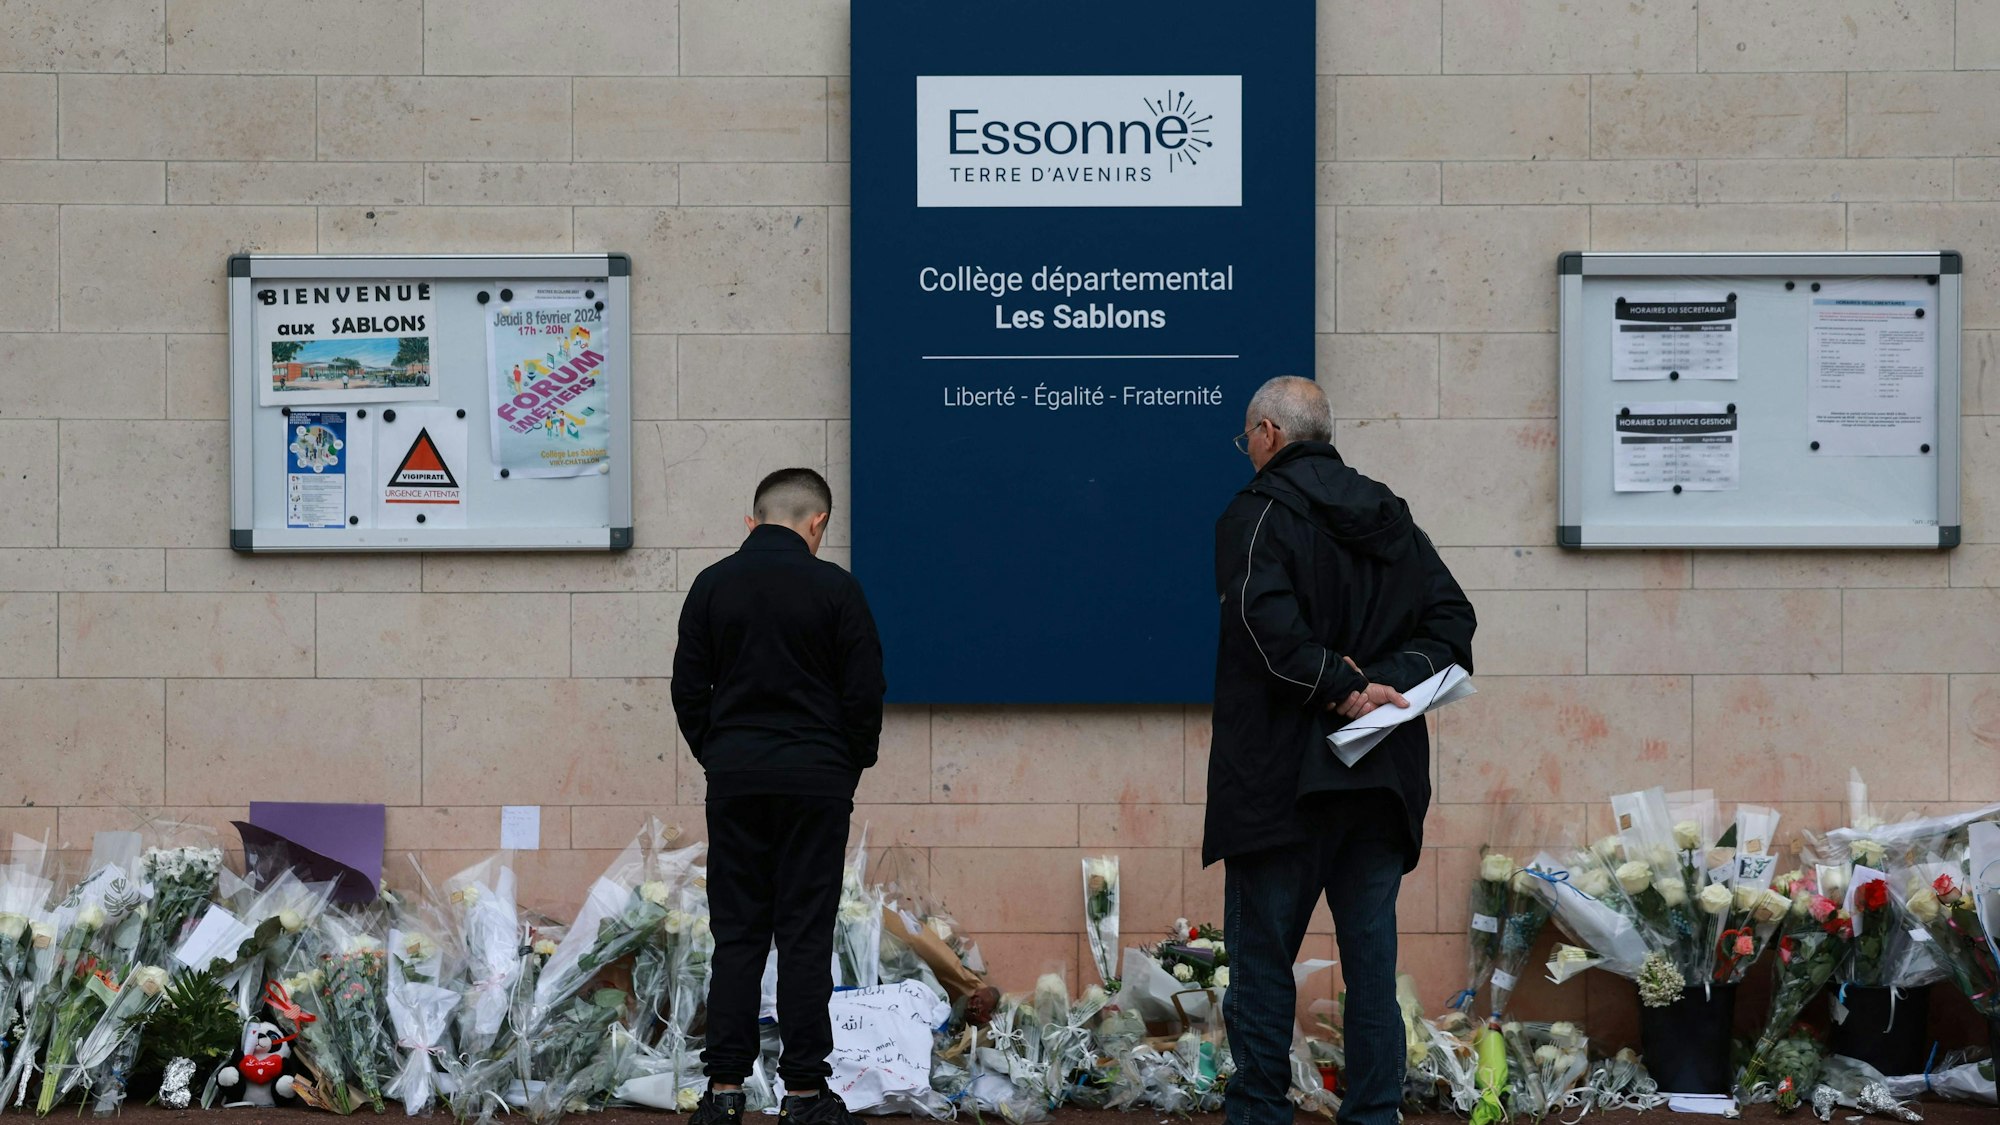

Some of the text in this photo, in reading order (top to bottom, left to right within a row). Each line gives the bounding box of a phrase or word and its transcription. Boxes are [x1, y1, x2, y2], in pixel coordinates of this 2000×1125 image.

[949, 109, 1188, 155] Essonne
[949, 167, 1022, 182] TERRE
[918, 265, 1234, 297] Collège départemental
[263, 284, 431, 306] BIENVENUE
[493, 308, 602, 327] Jeudi 8 février 2024
[995, 303, 1167, 329] Les Sablons
[1629, 306, 1666, 314] HORAIRES
[1667, 306, 1678, 314] DU
[277, 315, 426, 336] aux SABLONS
[518, 325, 536, 336] 17h
[545, 325, 564, 335] 20h
[497, 350, 604, 423] FORUM
[944, 386, 1016, 406] Liberté
[1034, 382, 1104, 410] Égalité
[1122, 385, 1223, 406] Fraternité
[515, 376, 594, 431] MÉTIERS
[1620, 417, 1732, 426] HORAIRES DU SERVICE GESTION
[385, 489, 460, 498] URGENCE ATTENTAT
